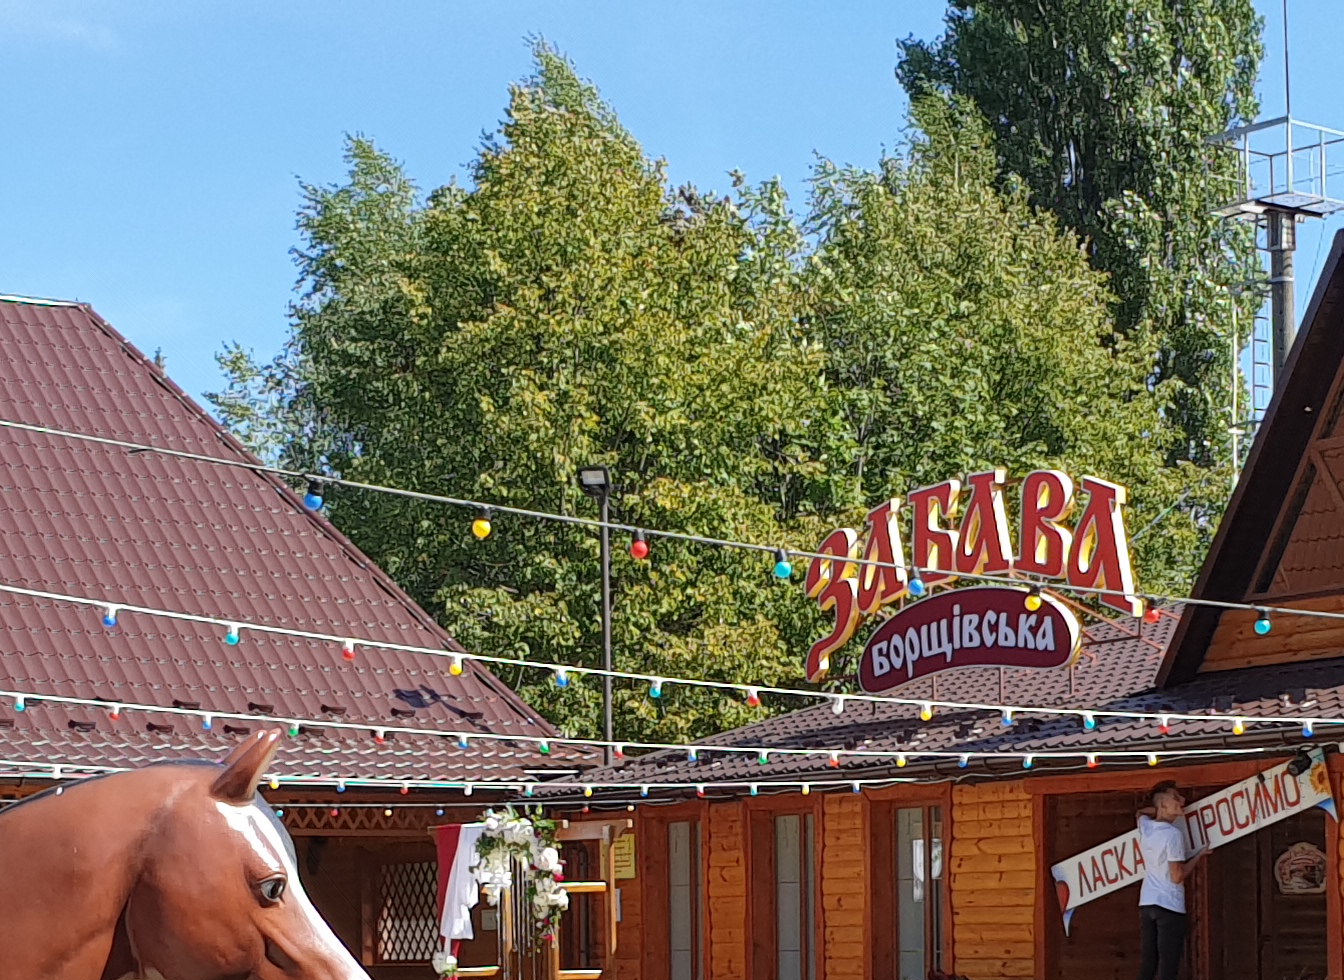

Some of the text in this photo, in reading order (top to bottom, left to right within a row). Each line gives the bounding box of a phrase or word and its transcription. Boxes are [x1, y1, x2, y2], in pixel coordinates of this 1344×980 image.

[805, 467, 1144, 683] ЗАБАВА
[1078, 769, 1301, 898] ЛАСКА ПРОСИМО
